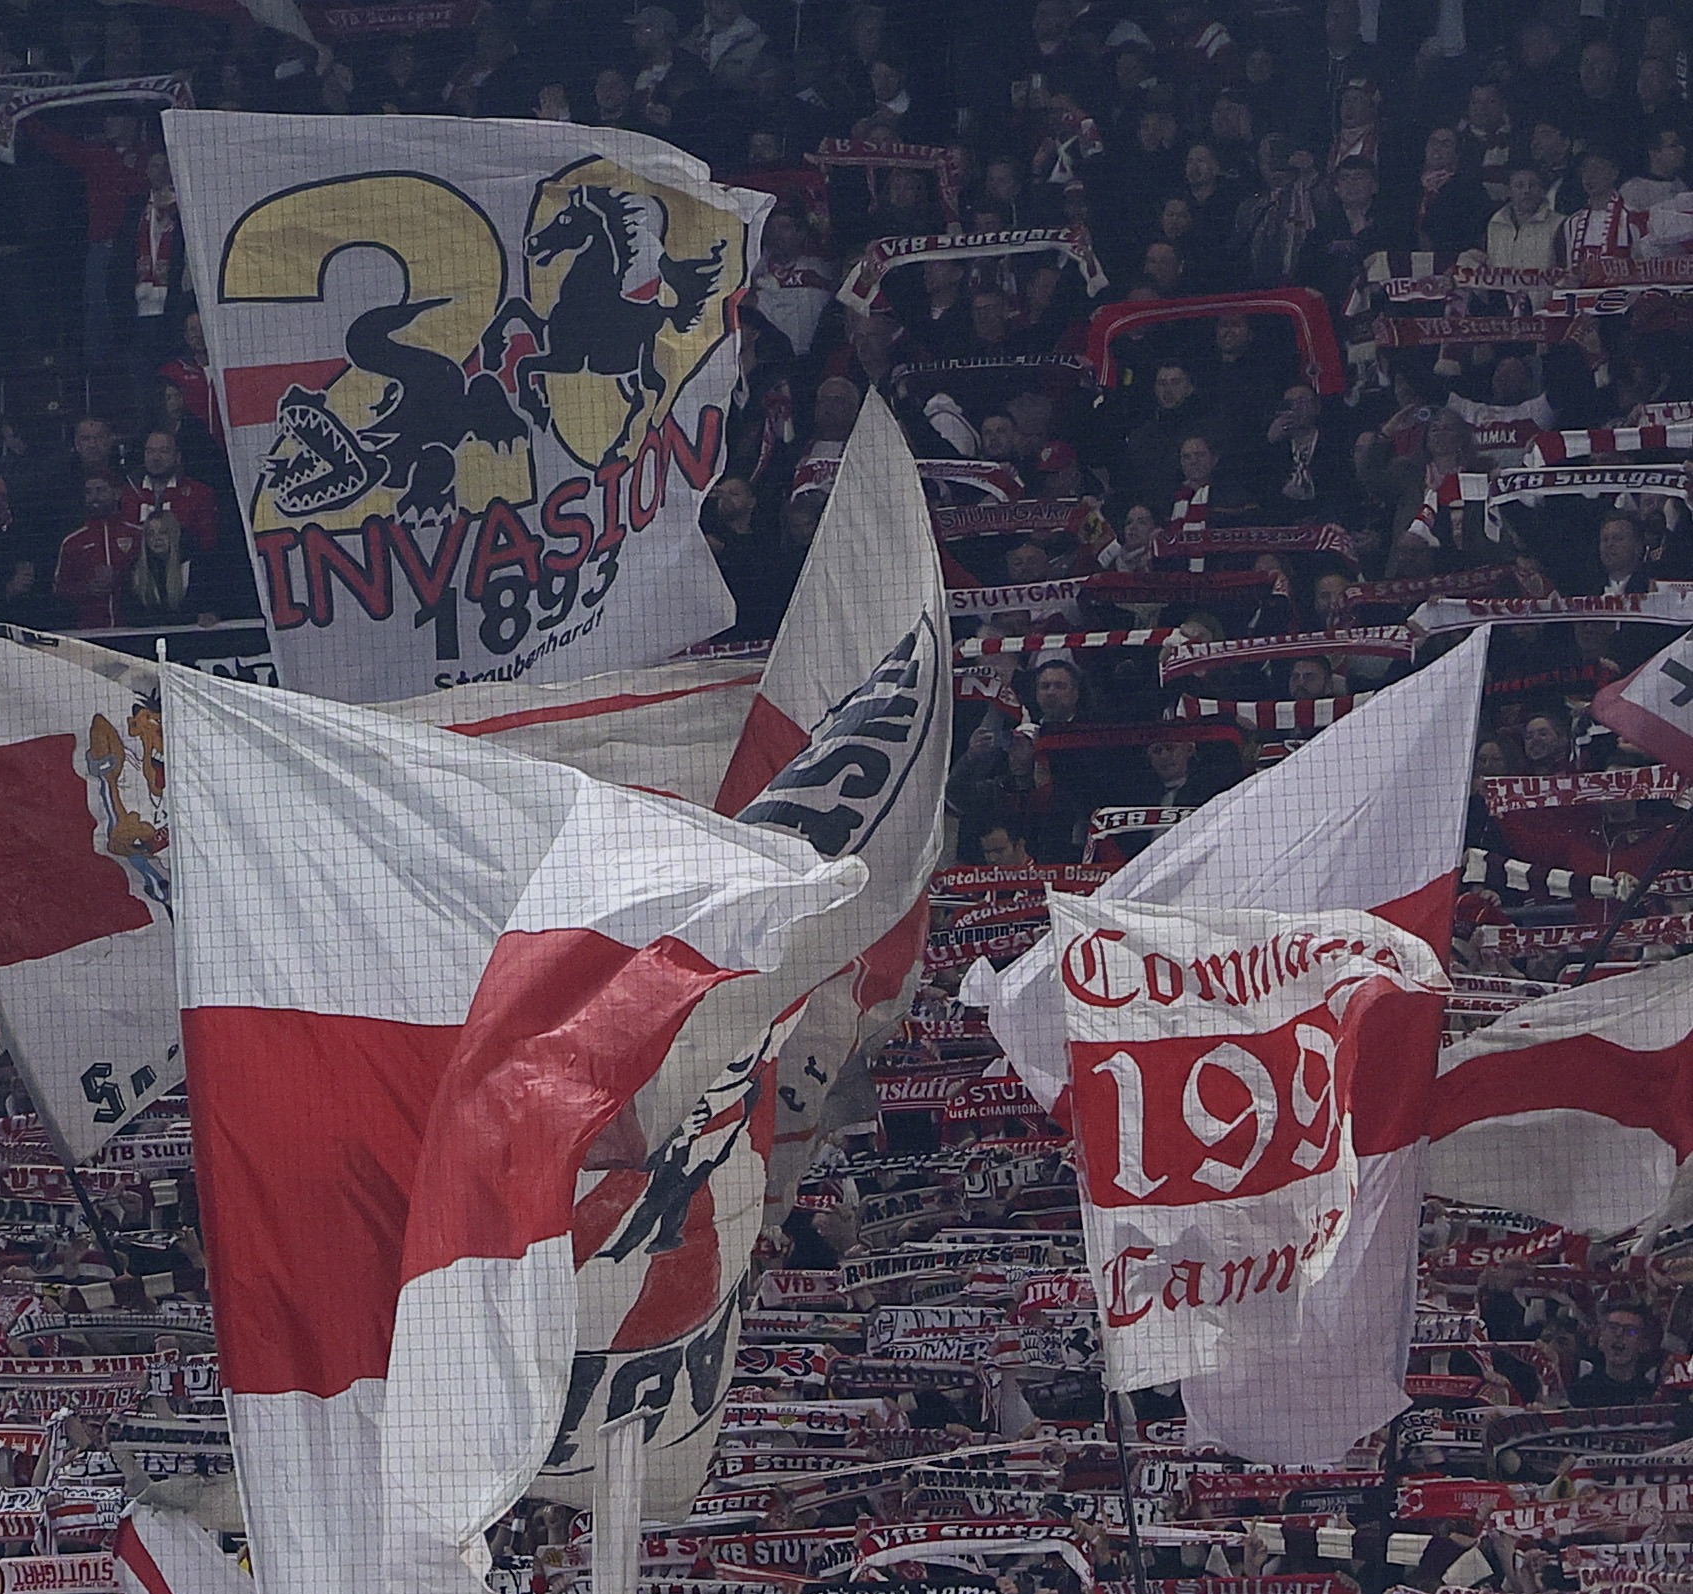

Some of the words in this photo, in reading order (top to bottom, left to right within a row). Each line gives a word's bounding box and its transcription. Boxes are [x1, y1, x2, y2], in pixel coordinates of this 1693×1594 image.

[253, 405, 723, 630] INVASION
[415, 555, 620, 660] 1893
[434, 610, 605, 689] Straubenhardt
[1090, 1022, 1354, 1206] 199
[1037, 1422, 1104, 1444] Bad
[870, 1529, 927, 1548] VfB
